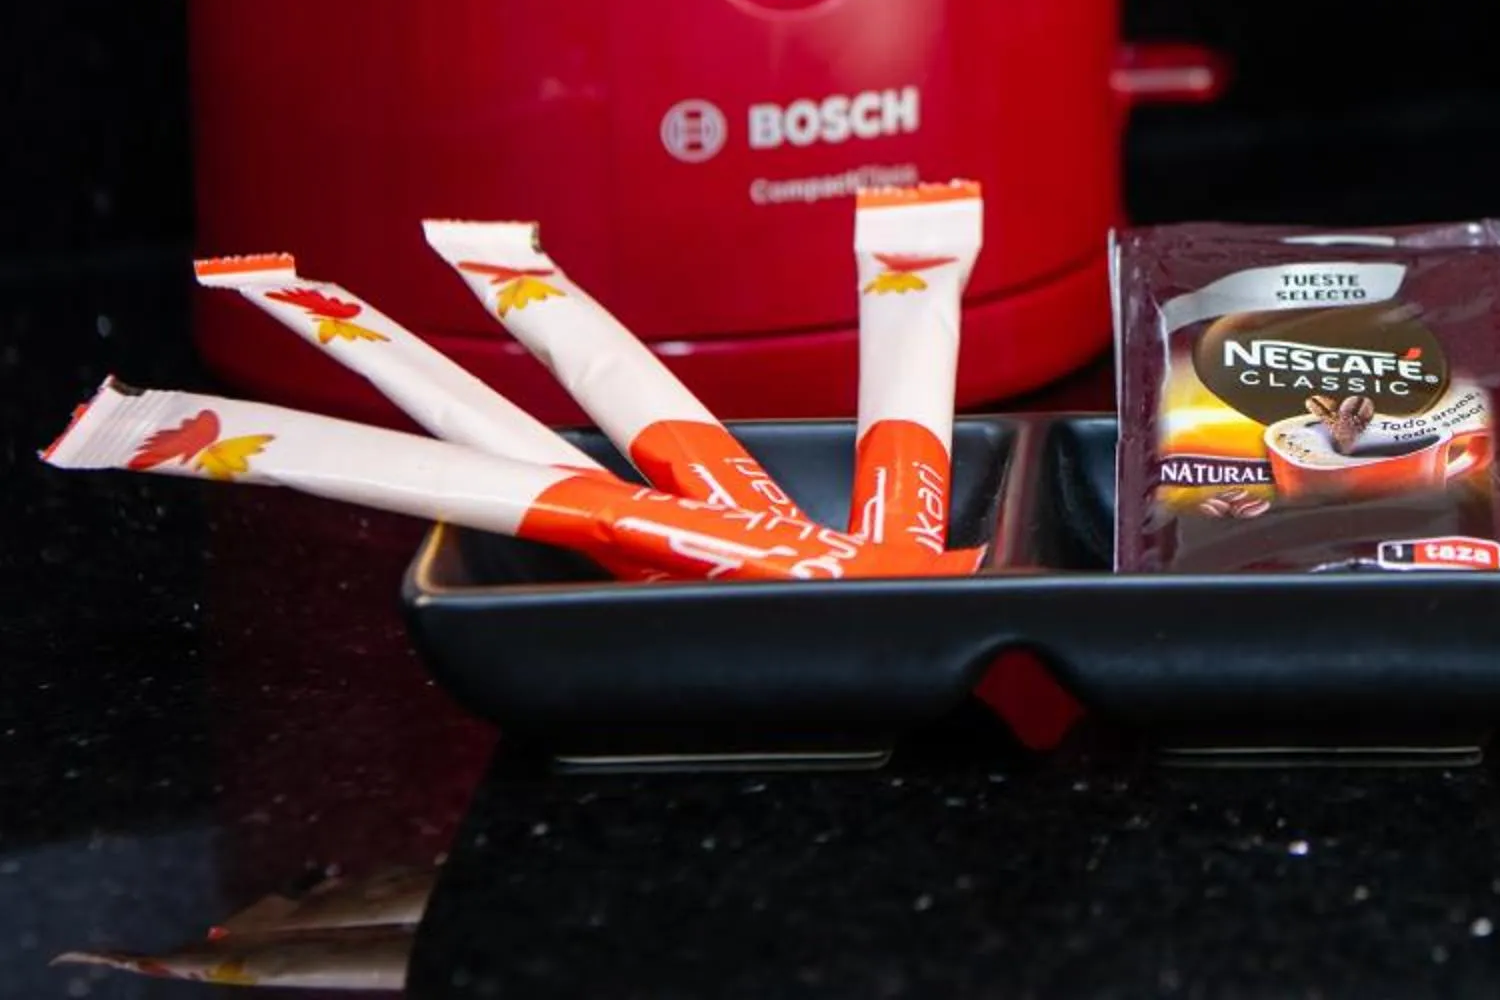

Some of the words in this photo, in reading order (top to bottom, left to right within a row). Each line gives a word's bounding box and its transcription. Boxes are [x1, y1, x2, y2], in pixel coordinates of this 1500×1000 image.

[748, 85, 919, 150] BOSCH
[1281, 273, 1359, 287] TUESTE
[1275, 287, 1367, 301] SELECTO
[1223, 339, 1423, 382] NESCAFÉ
[1239, 370, 1410, 395] CLASSIC
[1160, 462, 1270, 483] NATURAL
[1391, 545, 1403, 558] 1
[1424, 543, 1492, 565] taza
